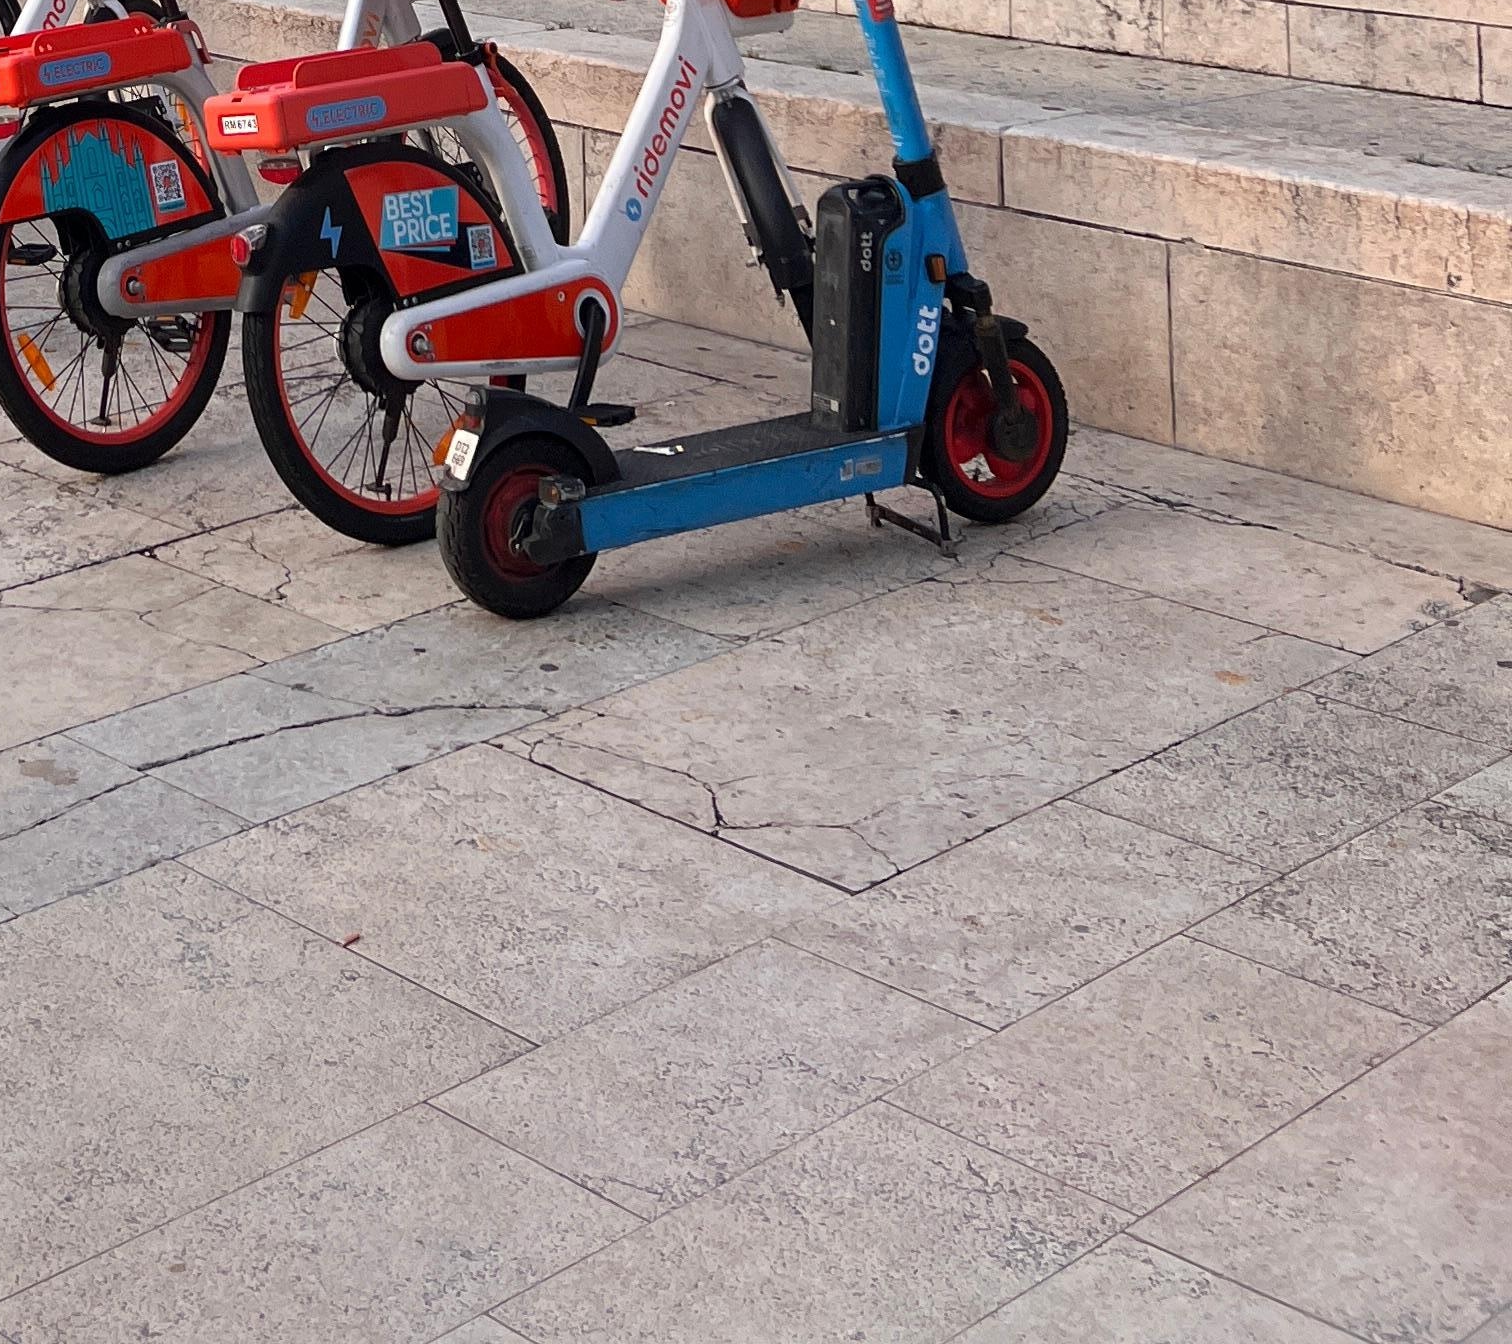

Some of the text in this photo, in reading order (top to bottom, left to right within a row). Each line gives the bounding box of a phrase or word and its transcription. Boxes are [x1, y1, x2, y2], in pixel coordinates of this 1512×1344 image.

[633, 55, 698, 199] ridemovi
[384, 190, 433, 221] BEST
[393, 213, 453, 246] PRICE
[860, 231, 873, 272] dott
[912, 305, 938, 376] dott
